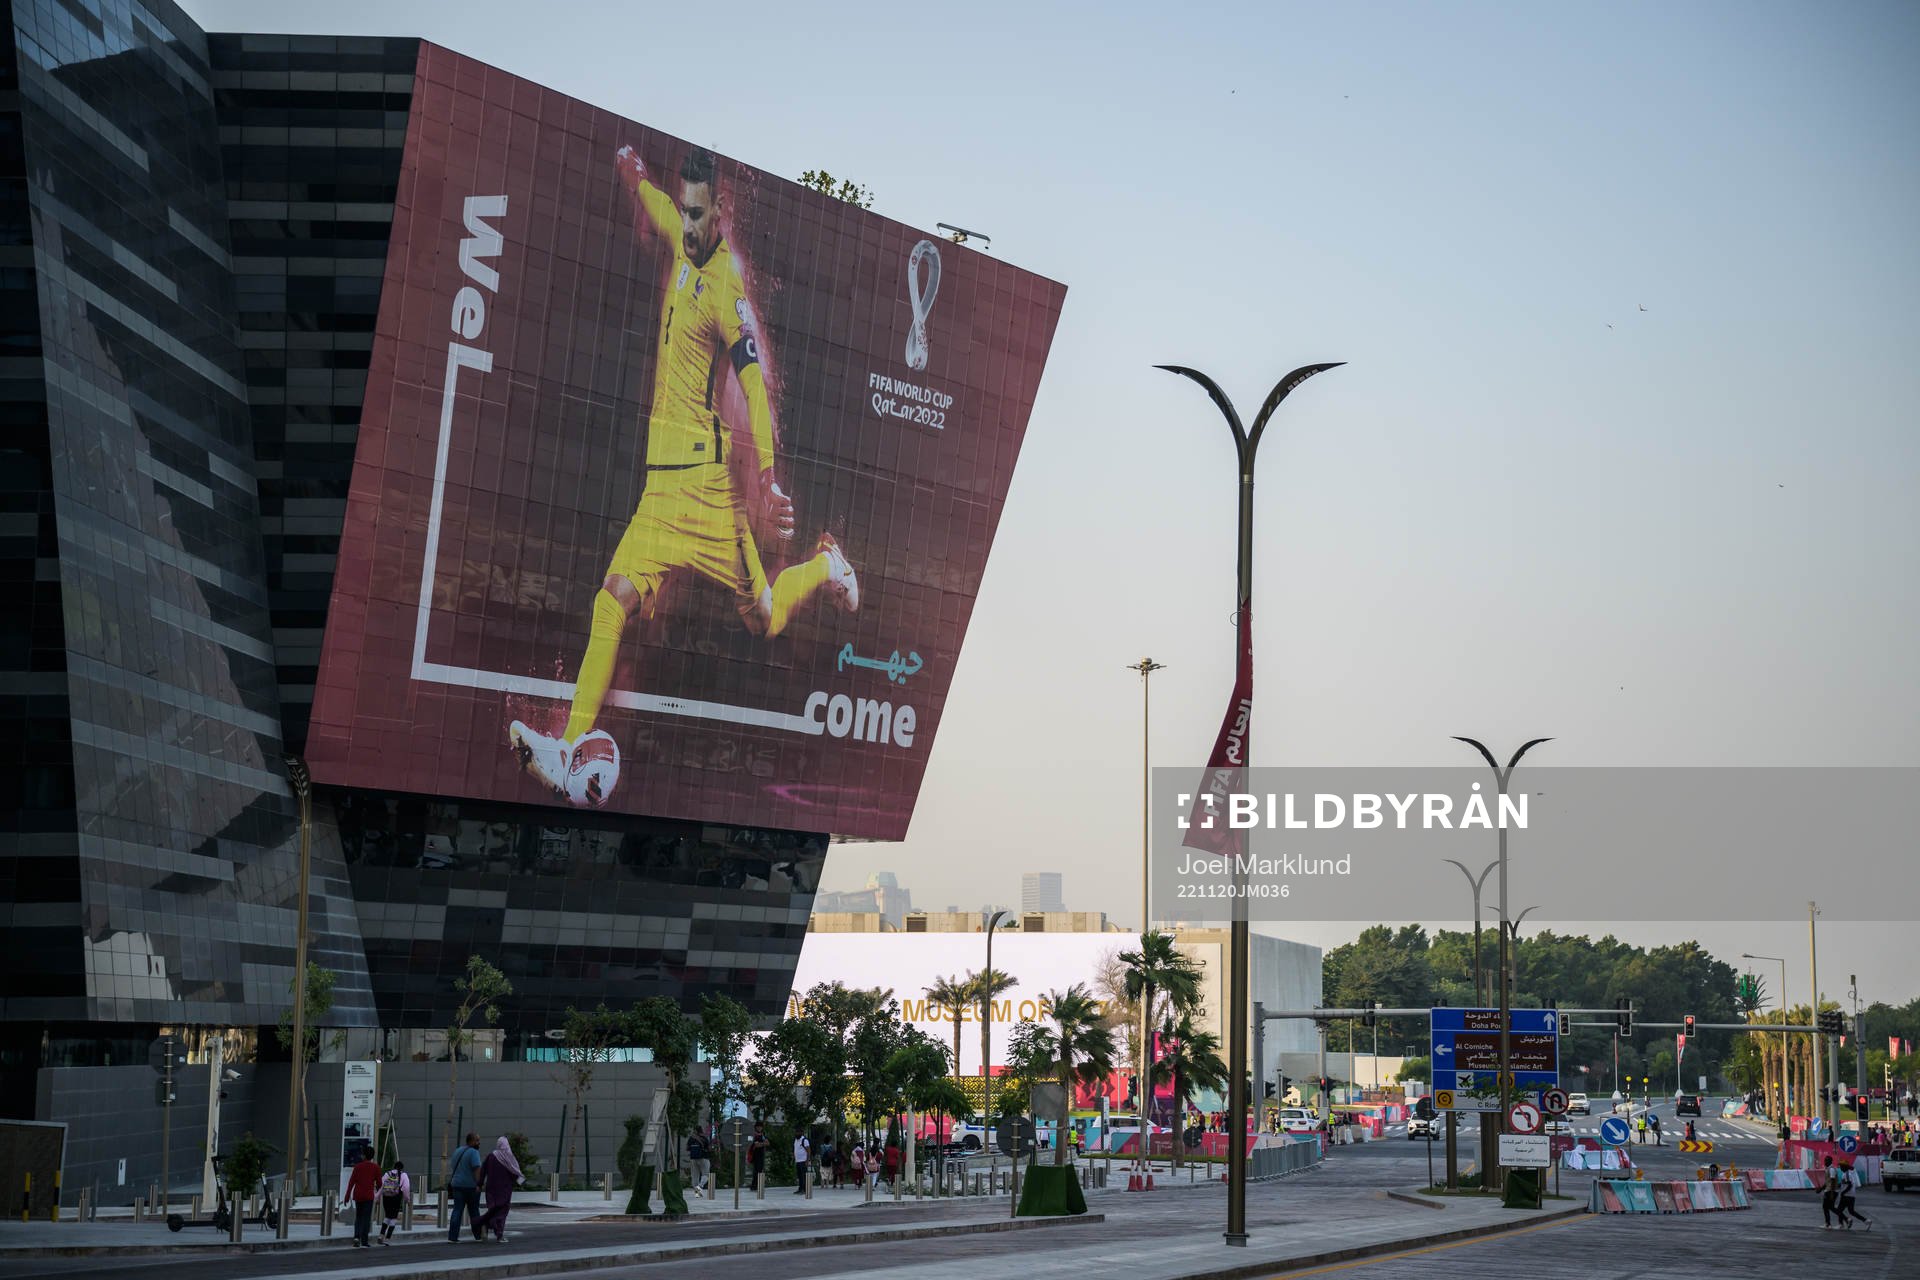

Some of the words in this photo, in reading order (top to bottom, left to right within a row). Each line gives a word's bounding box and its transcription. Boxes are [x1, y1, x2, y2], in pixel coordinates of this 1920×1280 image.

[869, 372, 892, 393] FIFA
[894, 379, 931, 403] WORLD
[932, 391, 953, 409] CUP
[804, 691, 916, 748] come
[1510, 1062, 1531, 1070] slamic
[1532, 1063, 1543, 1071] Art
